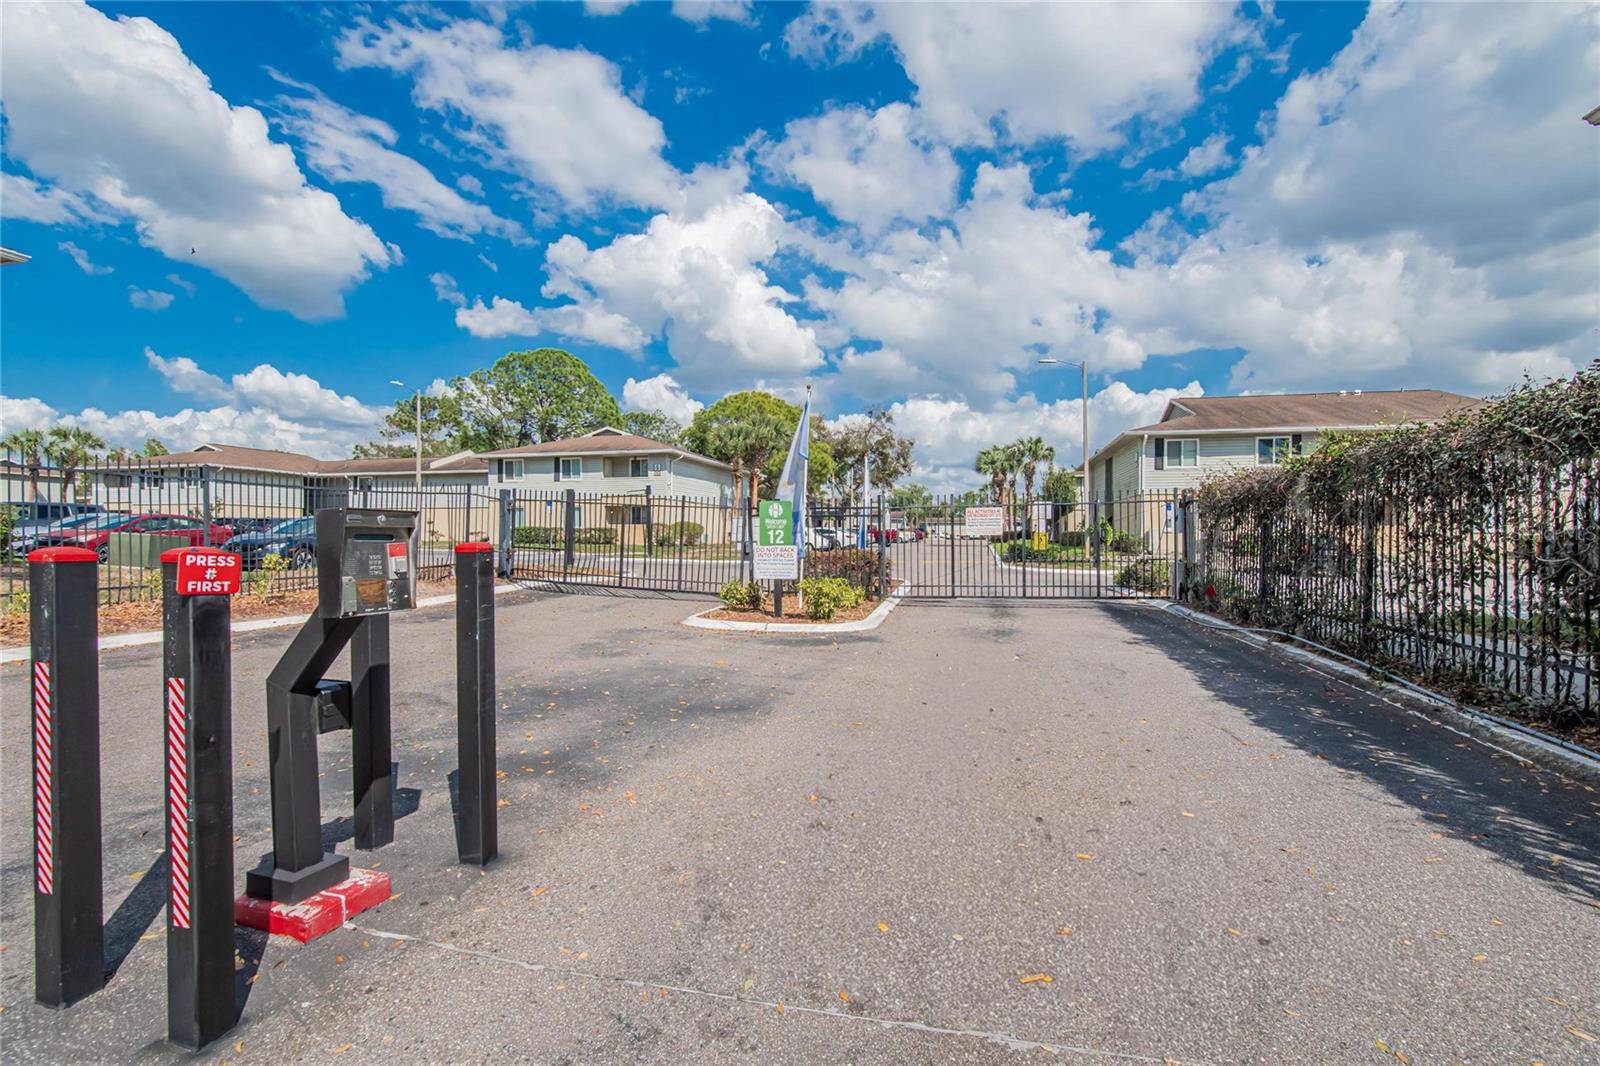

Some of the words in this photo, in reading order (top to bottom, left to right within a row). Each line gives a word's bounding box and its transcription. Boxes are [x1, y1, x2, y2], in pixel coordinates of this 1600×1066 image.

[768, 529, 785, 544] 12
[185, 555, 236, 567] PRESS
[204, 568, 217, 580] #
[187, 581, 231, 593] FIRST
